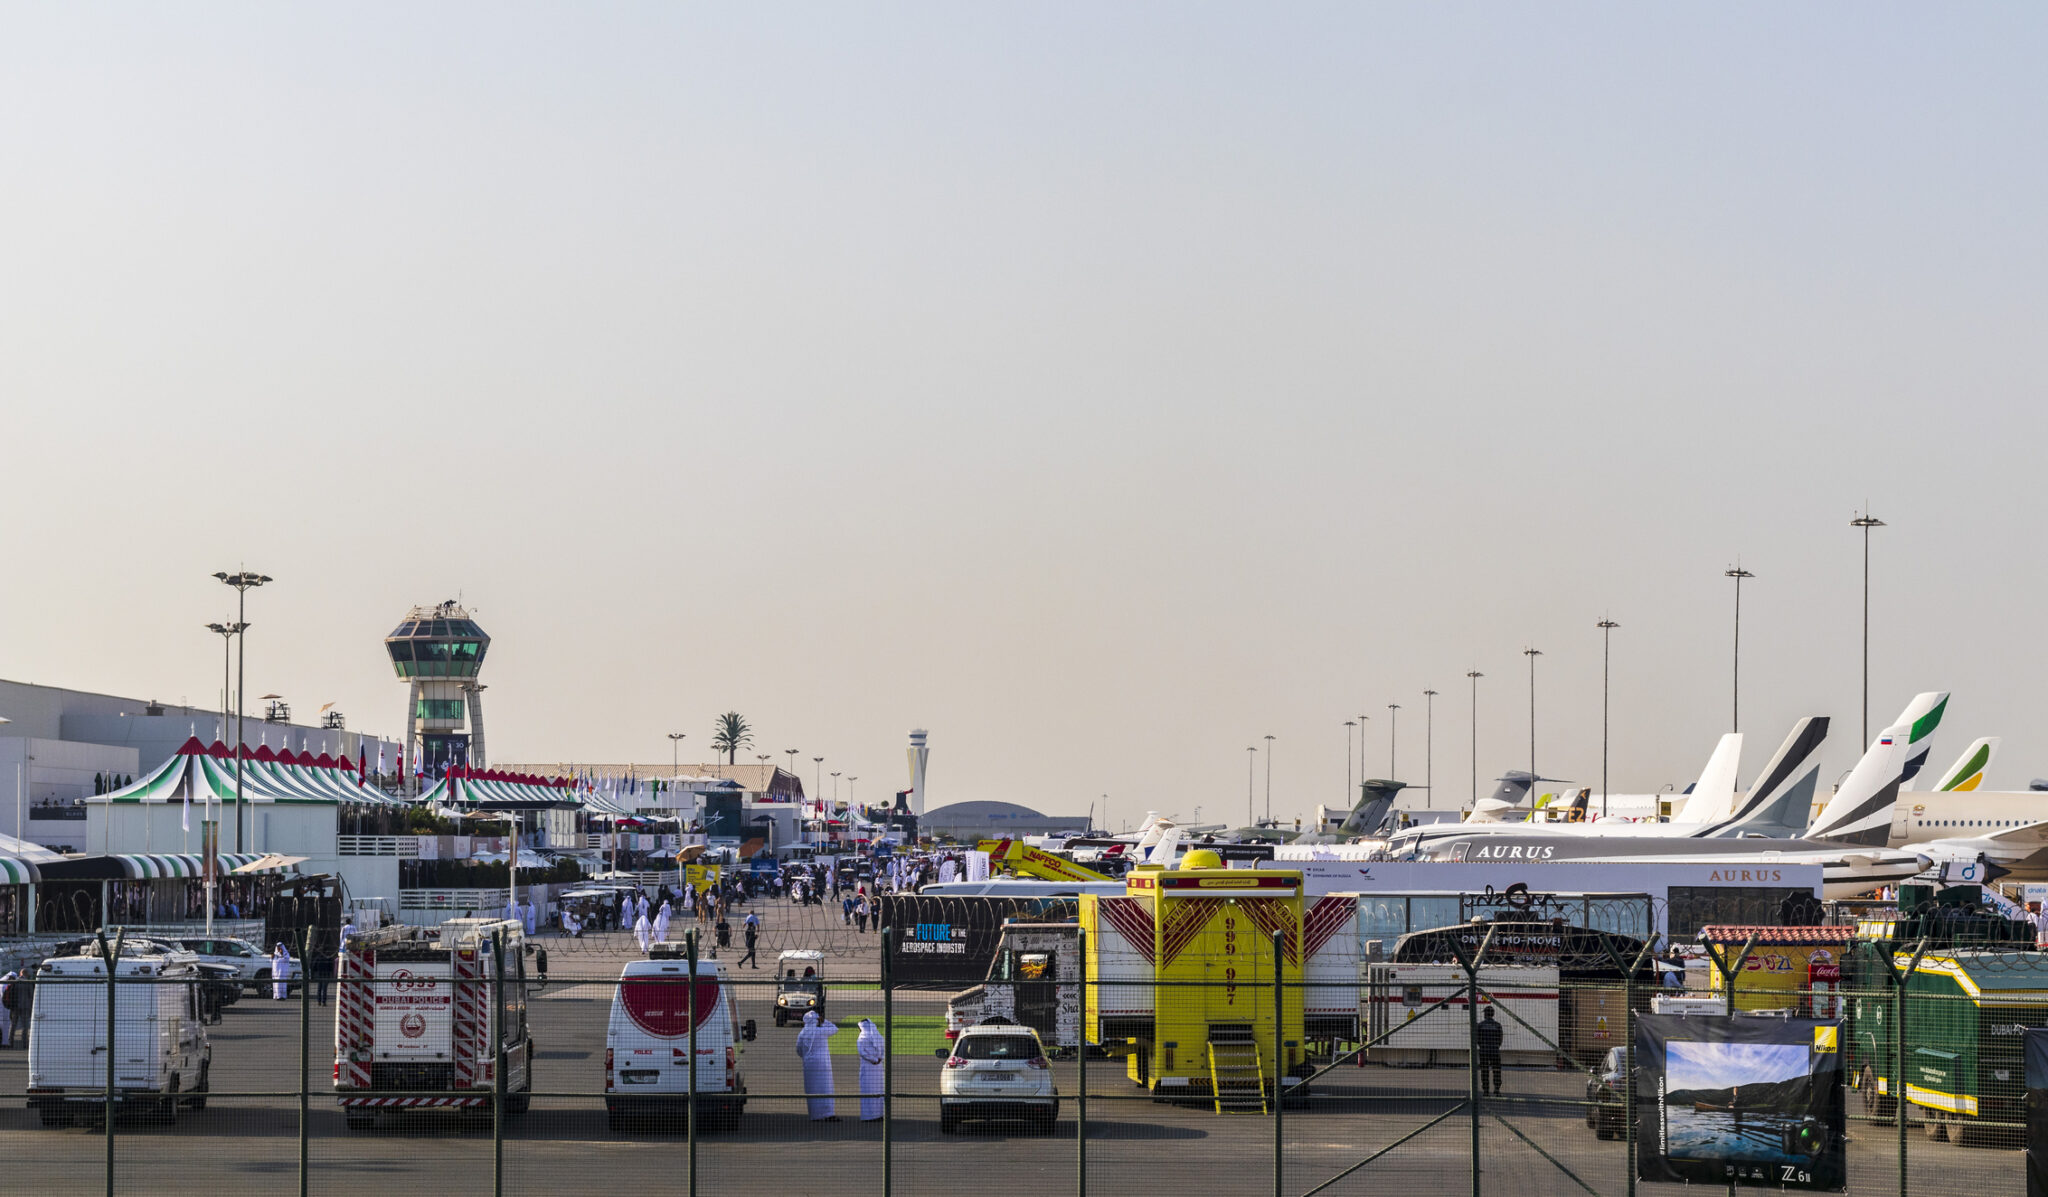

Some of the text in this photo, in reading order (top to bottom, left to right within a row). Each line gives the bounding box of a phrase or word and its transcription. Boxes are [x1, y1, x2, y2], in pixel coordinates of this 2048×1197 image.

[1568, 807, 1584, 823] E2
[1476, 846, 1554, 859] AURUS
[1029, 851, 1061, 868] NAFFCO
[1709, 870, 1781, 881] AURUS
[906, 928, 914, 936] THE
[917, 924, 952, 940] FUTURE
[952, 929, 957, 938] OF
[1461, 936, 1477, 944] ON
[902, 942, 966, 954] AEROSPACE INDUSTRY
[1992, 1025, 2012, 1035] DUBAI
[1781, 1166, 1796, 1182] Z
